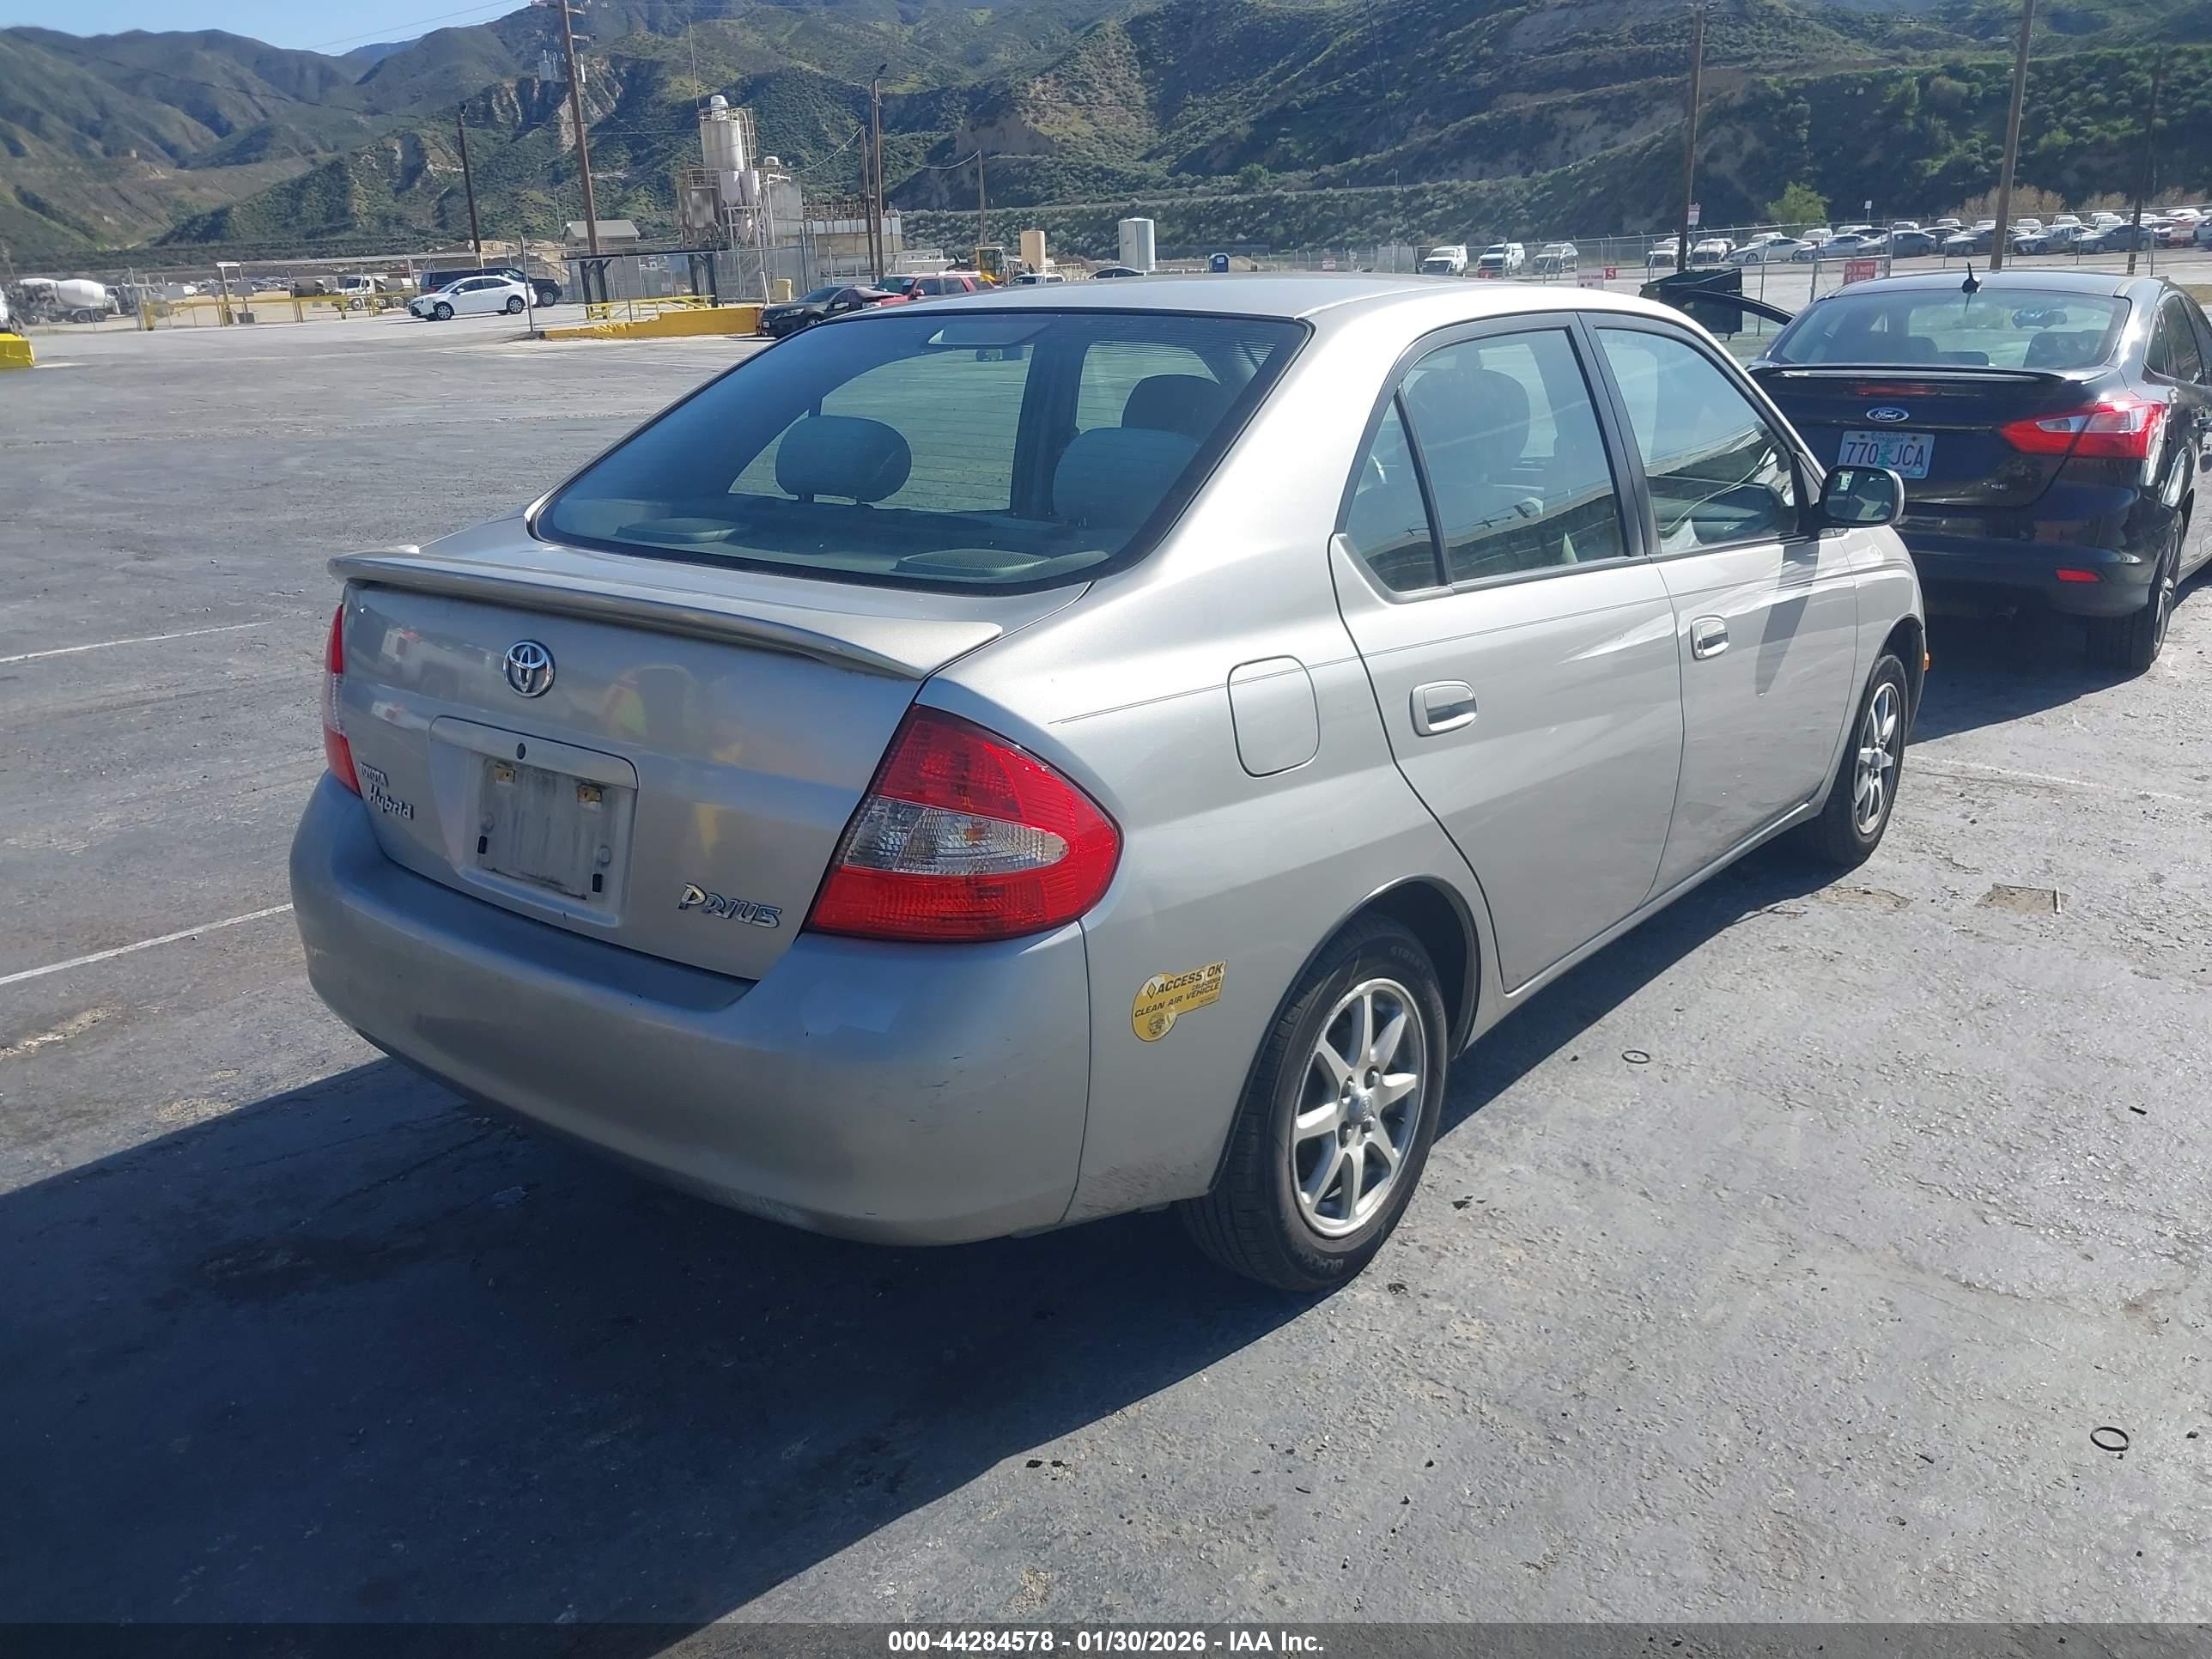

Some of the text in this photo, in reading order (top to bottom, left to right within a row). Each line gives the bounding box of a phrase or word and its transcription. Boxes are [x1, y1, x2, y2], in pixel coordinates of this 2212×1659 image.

[1859, 265, 1875, 274] NOT
[1846, 441, 1924, 467] 770 JCA
[359, 762, 387, 786] TOYOTA
[368, 782, 412, 820] Hybrid
[1156, 963, 1224, 995] ACCESS OK
[1134, 1001, 1166, 1018] CLEAN
[1167, 995, 1183, 1006] AIR
[1186, 982, 1220, 1000] VEHICLE
